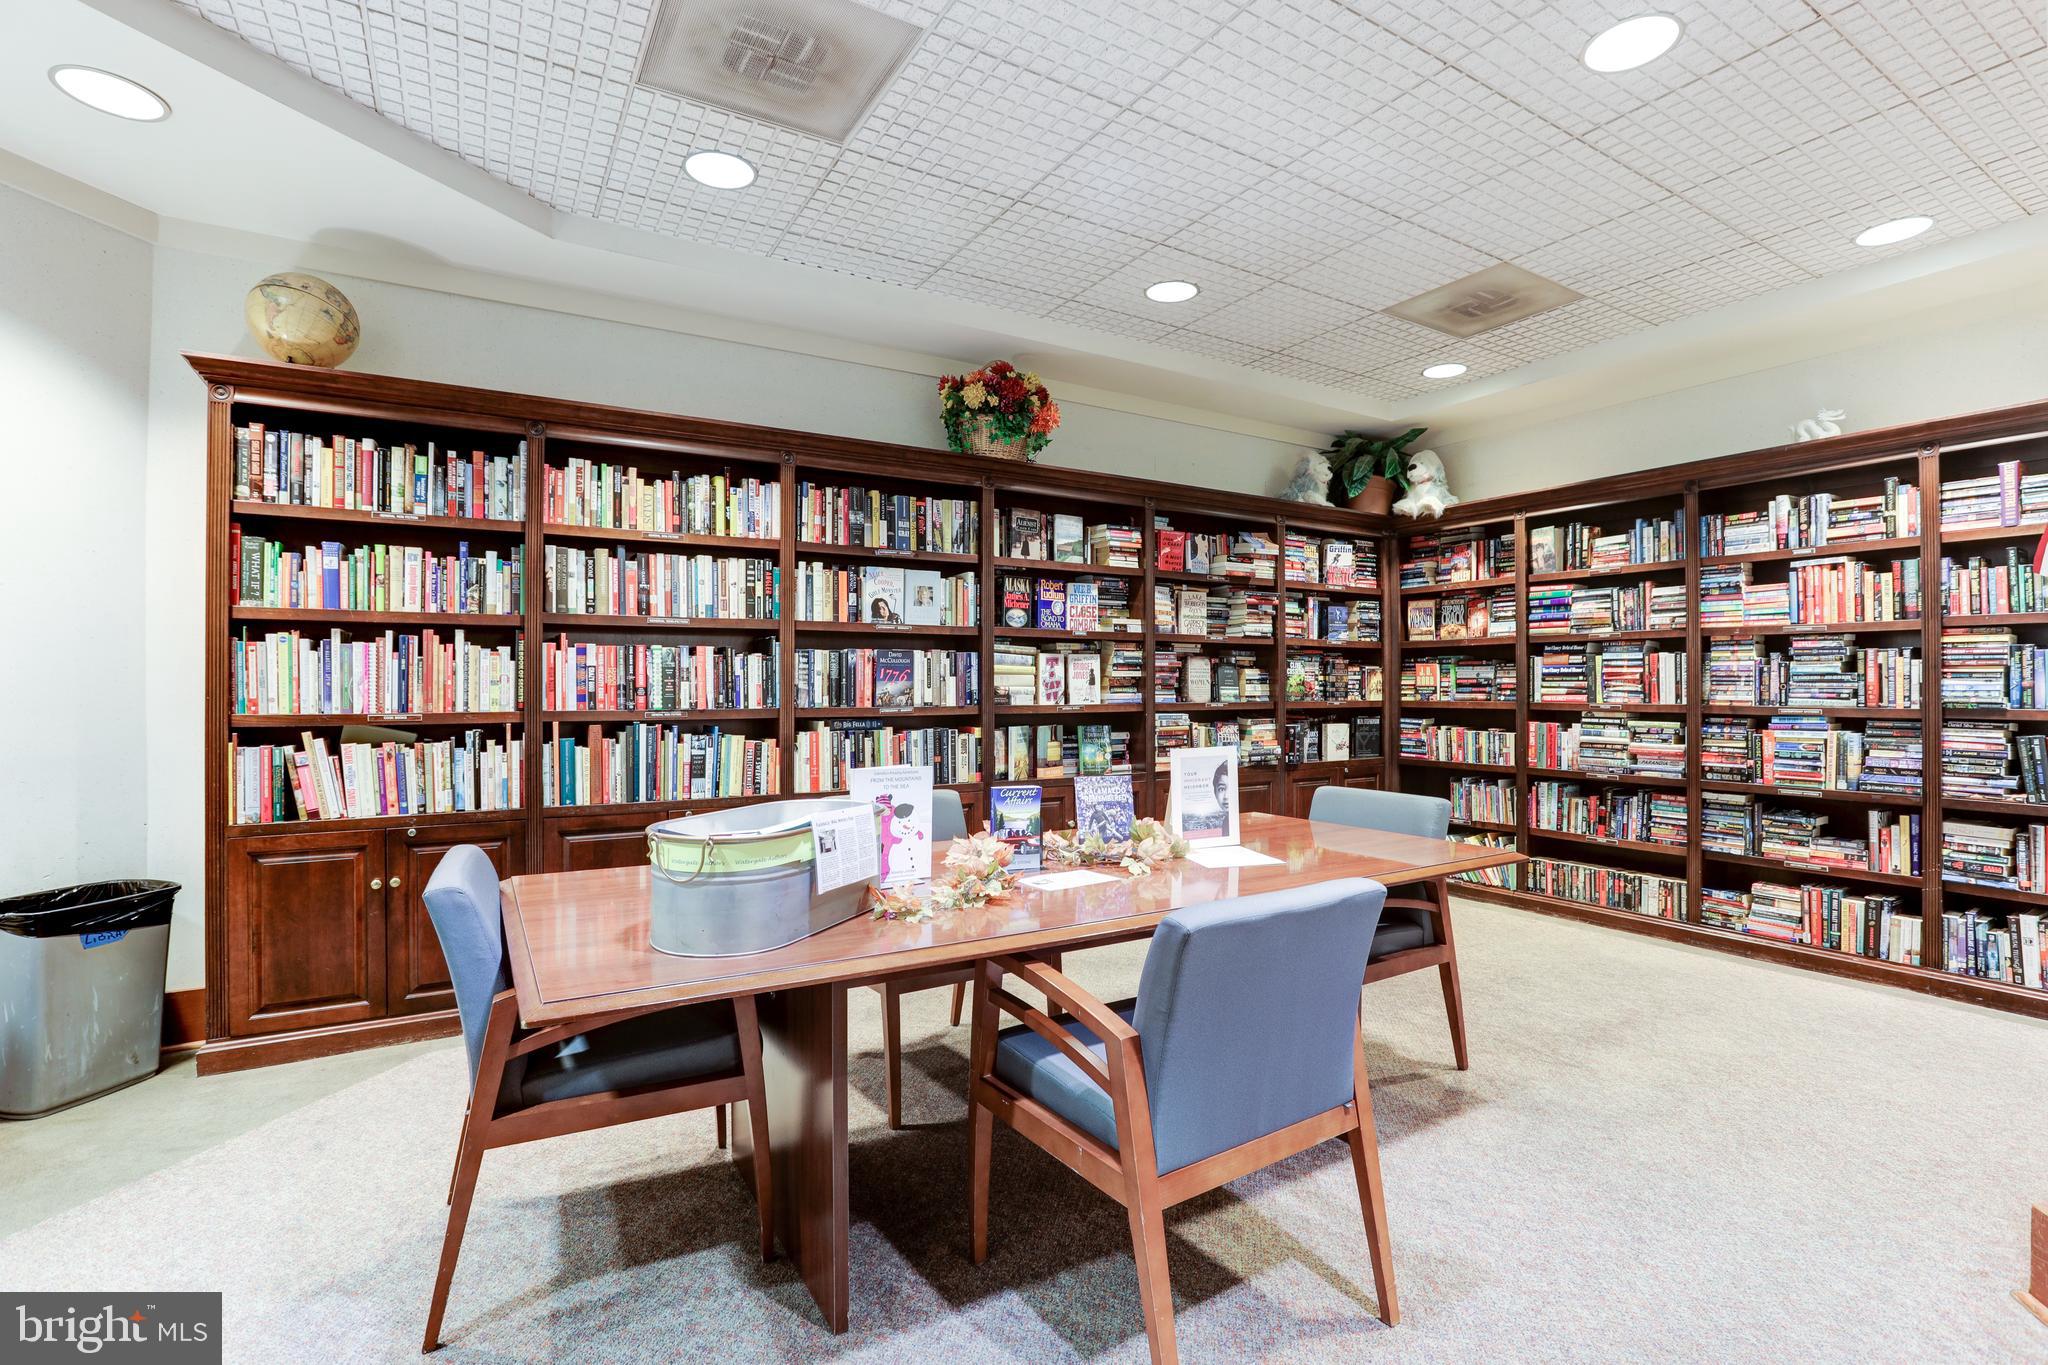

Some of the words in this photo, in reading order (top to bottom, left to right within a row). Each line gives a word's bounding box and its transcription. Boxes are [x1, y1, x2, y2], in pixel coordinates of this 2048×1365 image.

[643, 493, 653, 524] DADS
[1328, 545, 1352, 553] Griffin
[251, 552, 260, 579] WHAT
[251, 581, 260, 590] IF
[1005, 577, 1030, 592] ALASKA
[1040, 579, 1064, 591] Robert
[1073, 584, 1092, 594] W.E.B.
[1005, 592, 1024, 601] James
[1041, 589, 1065, 601] Ludlum
[1069, 593, 1097, 605] GRIFFIN
[1005, 599, 1030, 609] Michener
[1441, 605, 1452, 614] STEP
[1451, 605, 1460, 614] ON
[1041, 608, 1052, 616] THE
[1069, 605, 1097, 618] CLOSE
[1041, 615, 1058, 623] ROAD
[1441, 612, 1465, 625] CRACK
[1069, 618, 1097, 632] COMBAT
[1073, 662, 1093, 671] BRIDGET
[880, 667, 911, 686] 1776
[1072, 671, 1089, 680] JONES
[746, 748, 754, 768] PUBLIC
[1000, 787, 1038, 798] Current
[1002, 796, 1033, 806] Affairs
[85, 930, 127, 945] LIBRA
